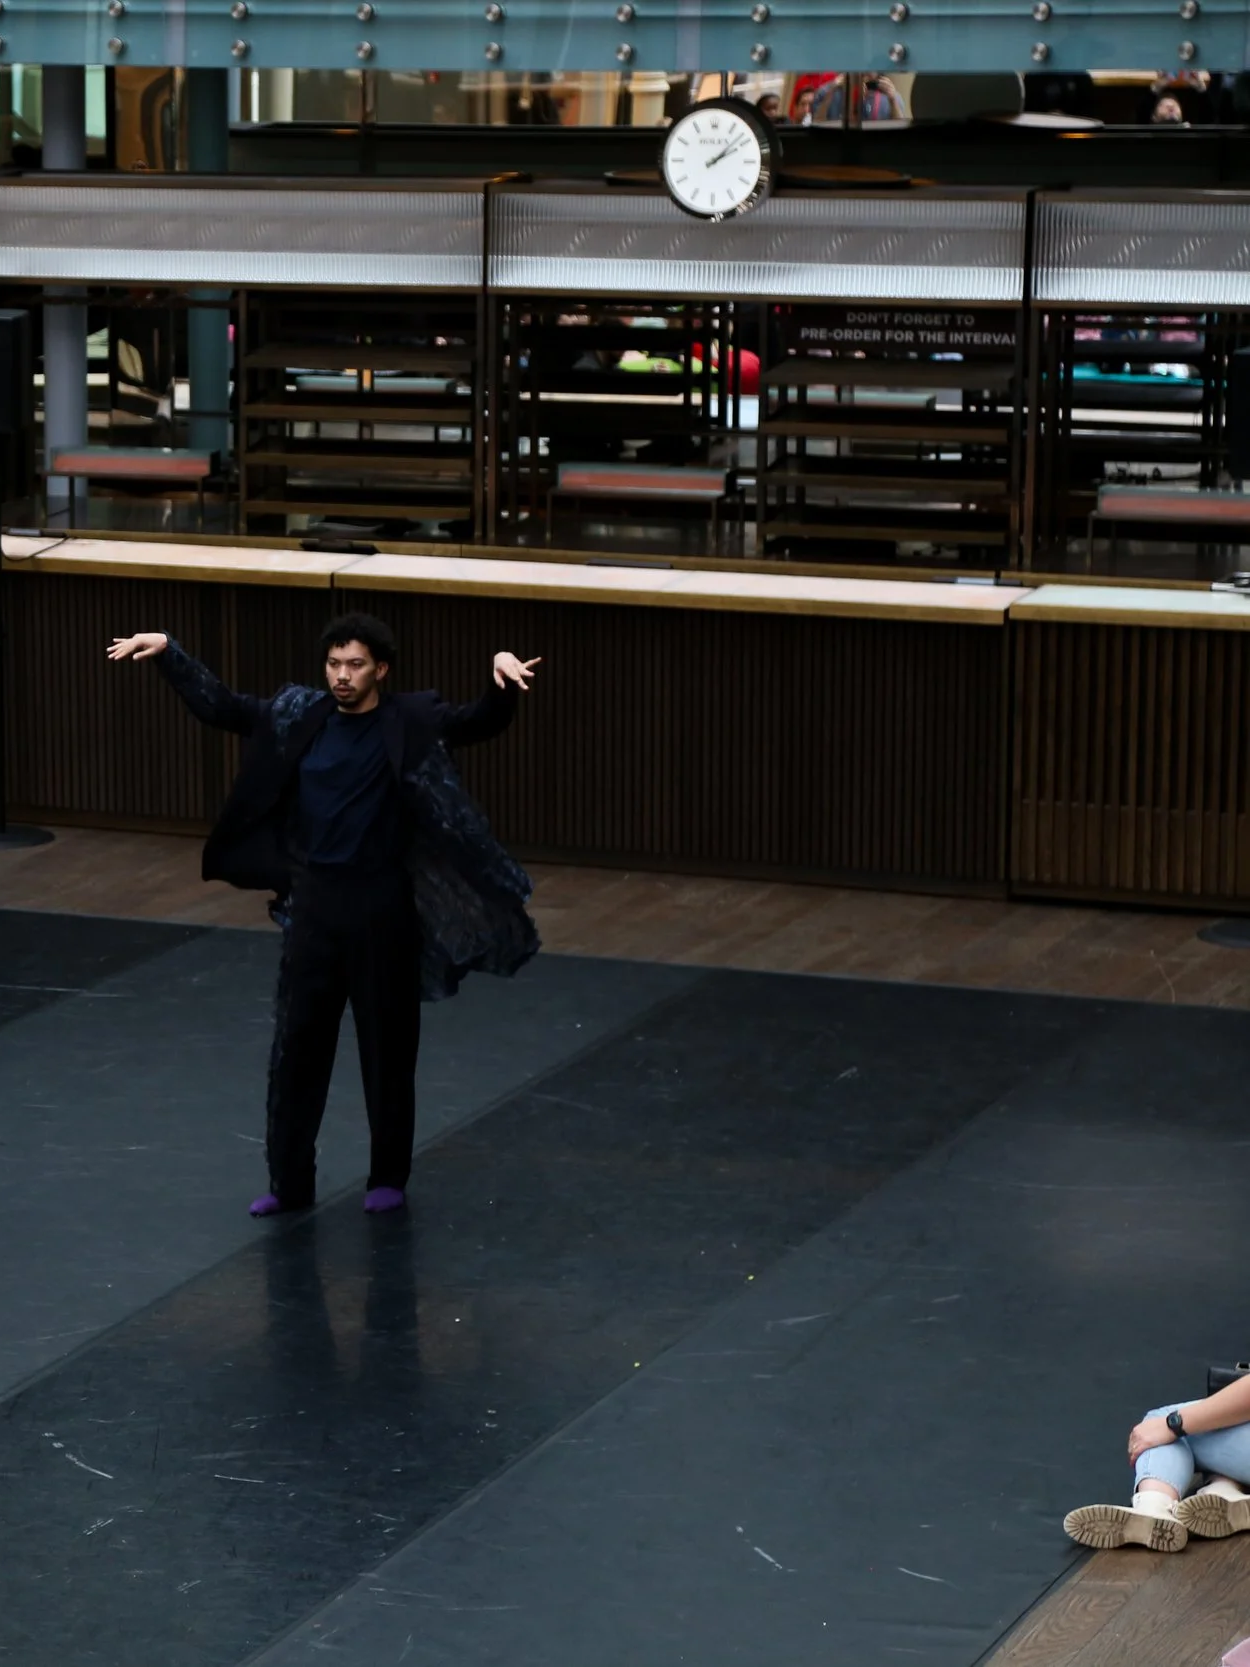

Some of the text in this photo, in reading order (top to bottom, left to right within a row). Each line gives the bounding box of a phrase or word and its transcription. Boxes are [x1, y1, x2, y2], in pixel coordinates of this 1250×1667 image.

[846, 312, 975, 326] DON'T FORGET TO
[801, 327, 881, 341] PRE-ORDER
[885, 329, 914, 342] FOR
[918, 330, 946, 343] THE
